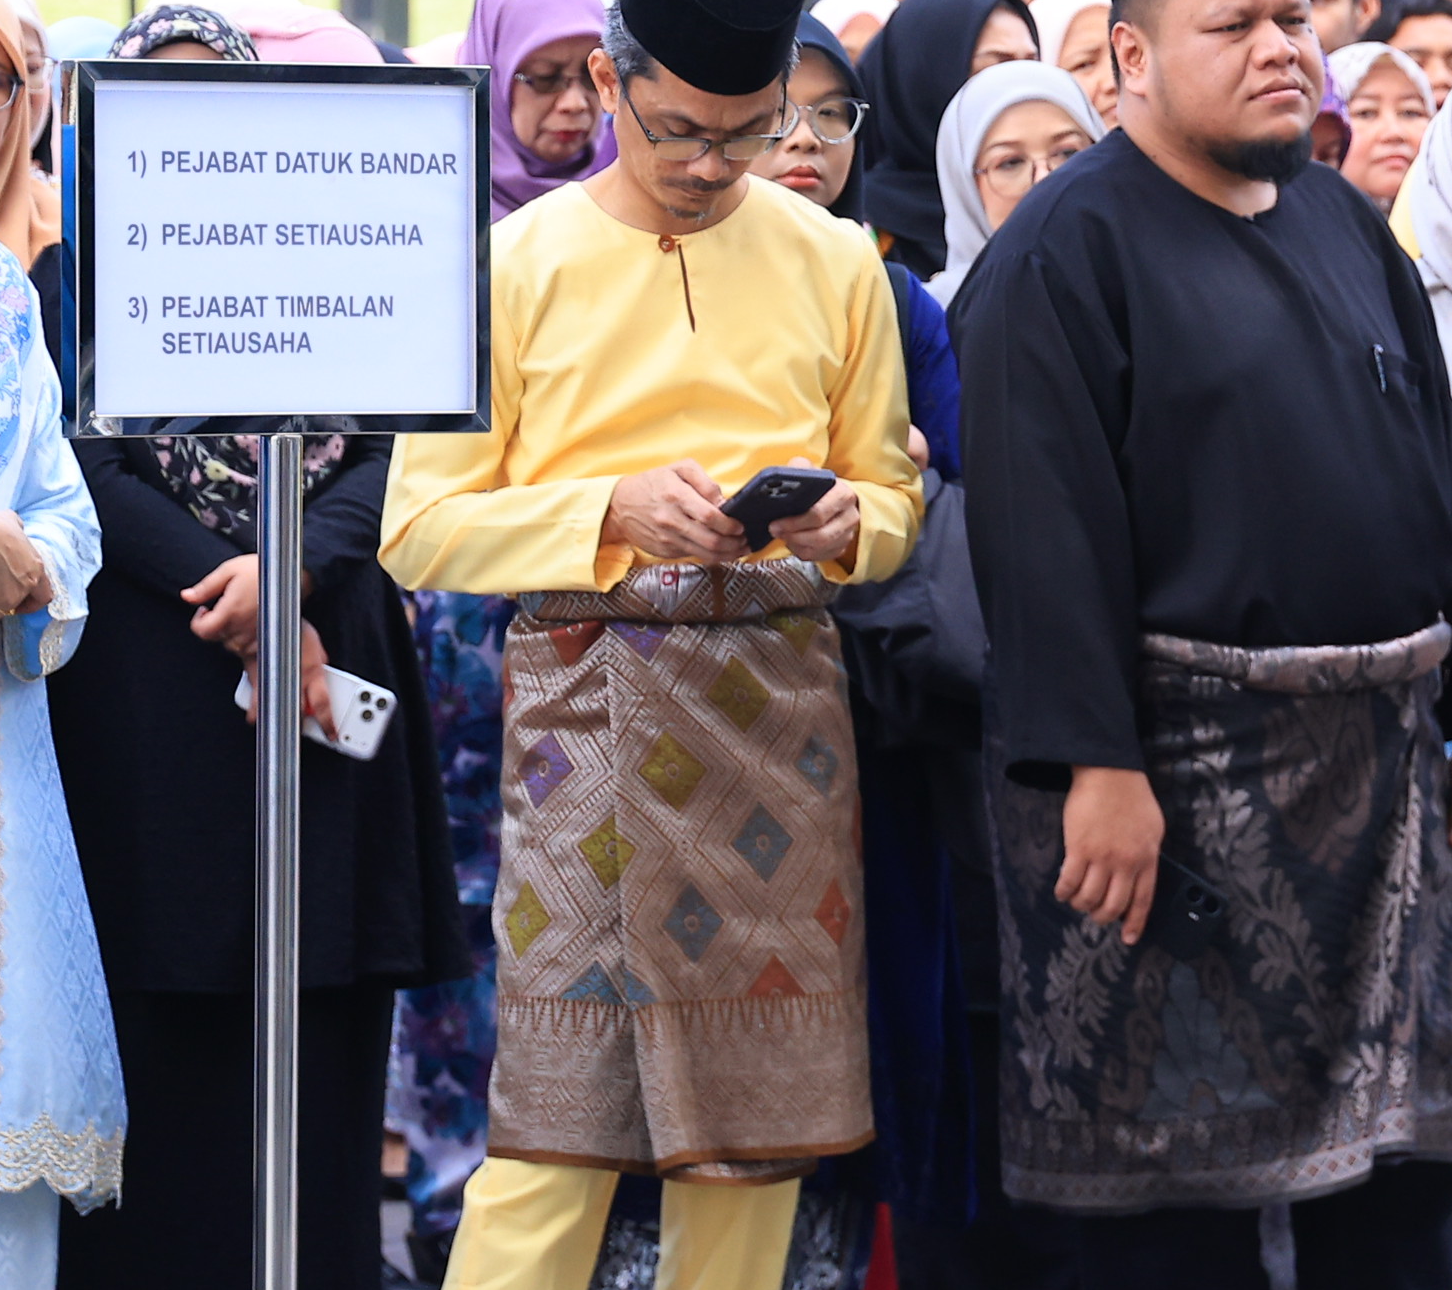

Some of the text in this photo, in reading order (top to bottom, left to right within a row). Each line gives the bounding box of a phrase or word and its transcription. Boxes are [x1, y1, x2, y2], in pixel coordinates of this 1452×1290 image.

[127, 151, 458, 178] 1) PEJABAT DATUK BANDAR
[127, 223, 424, 251] 2) PEJABAT SETIAUSAHA
[128, 295, 394, 324] 3) PEJABAT TIMBALAN
[162, 332, 312, 354] SETIAUSAHA
